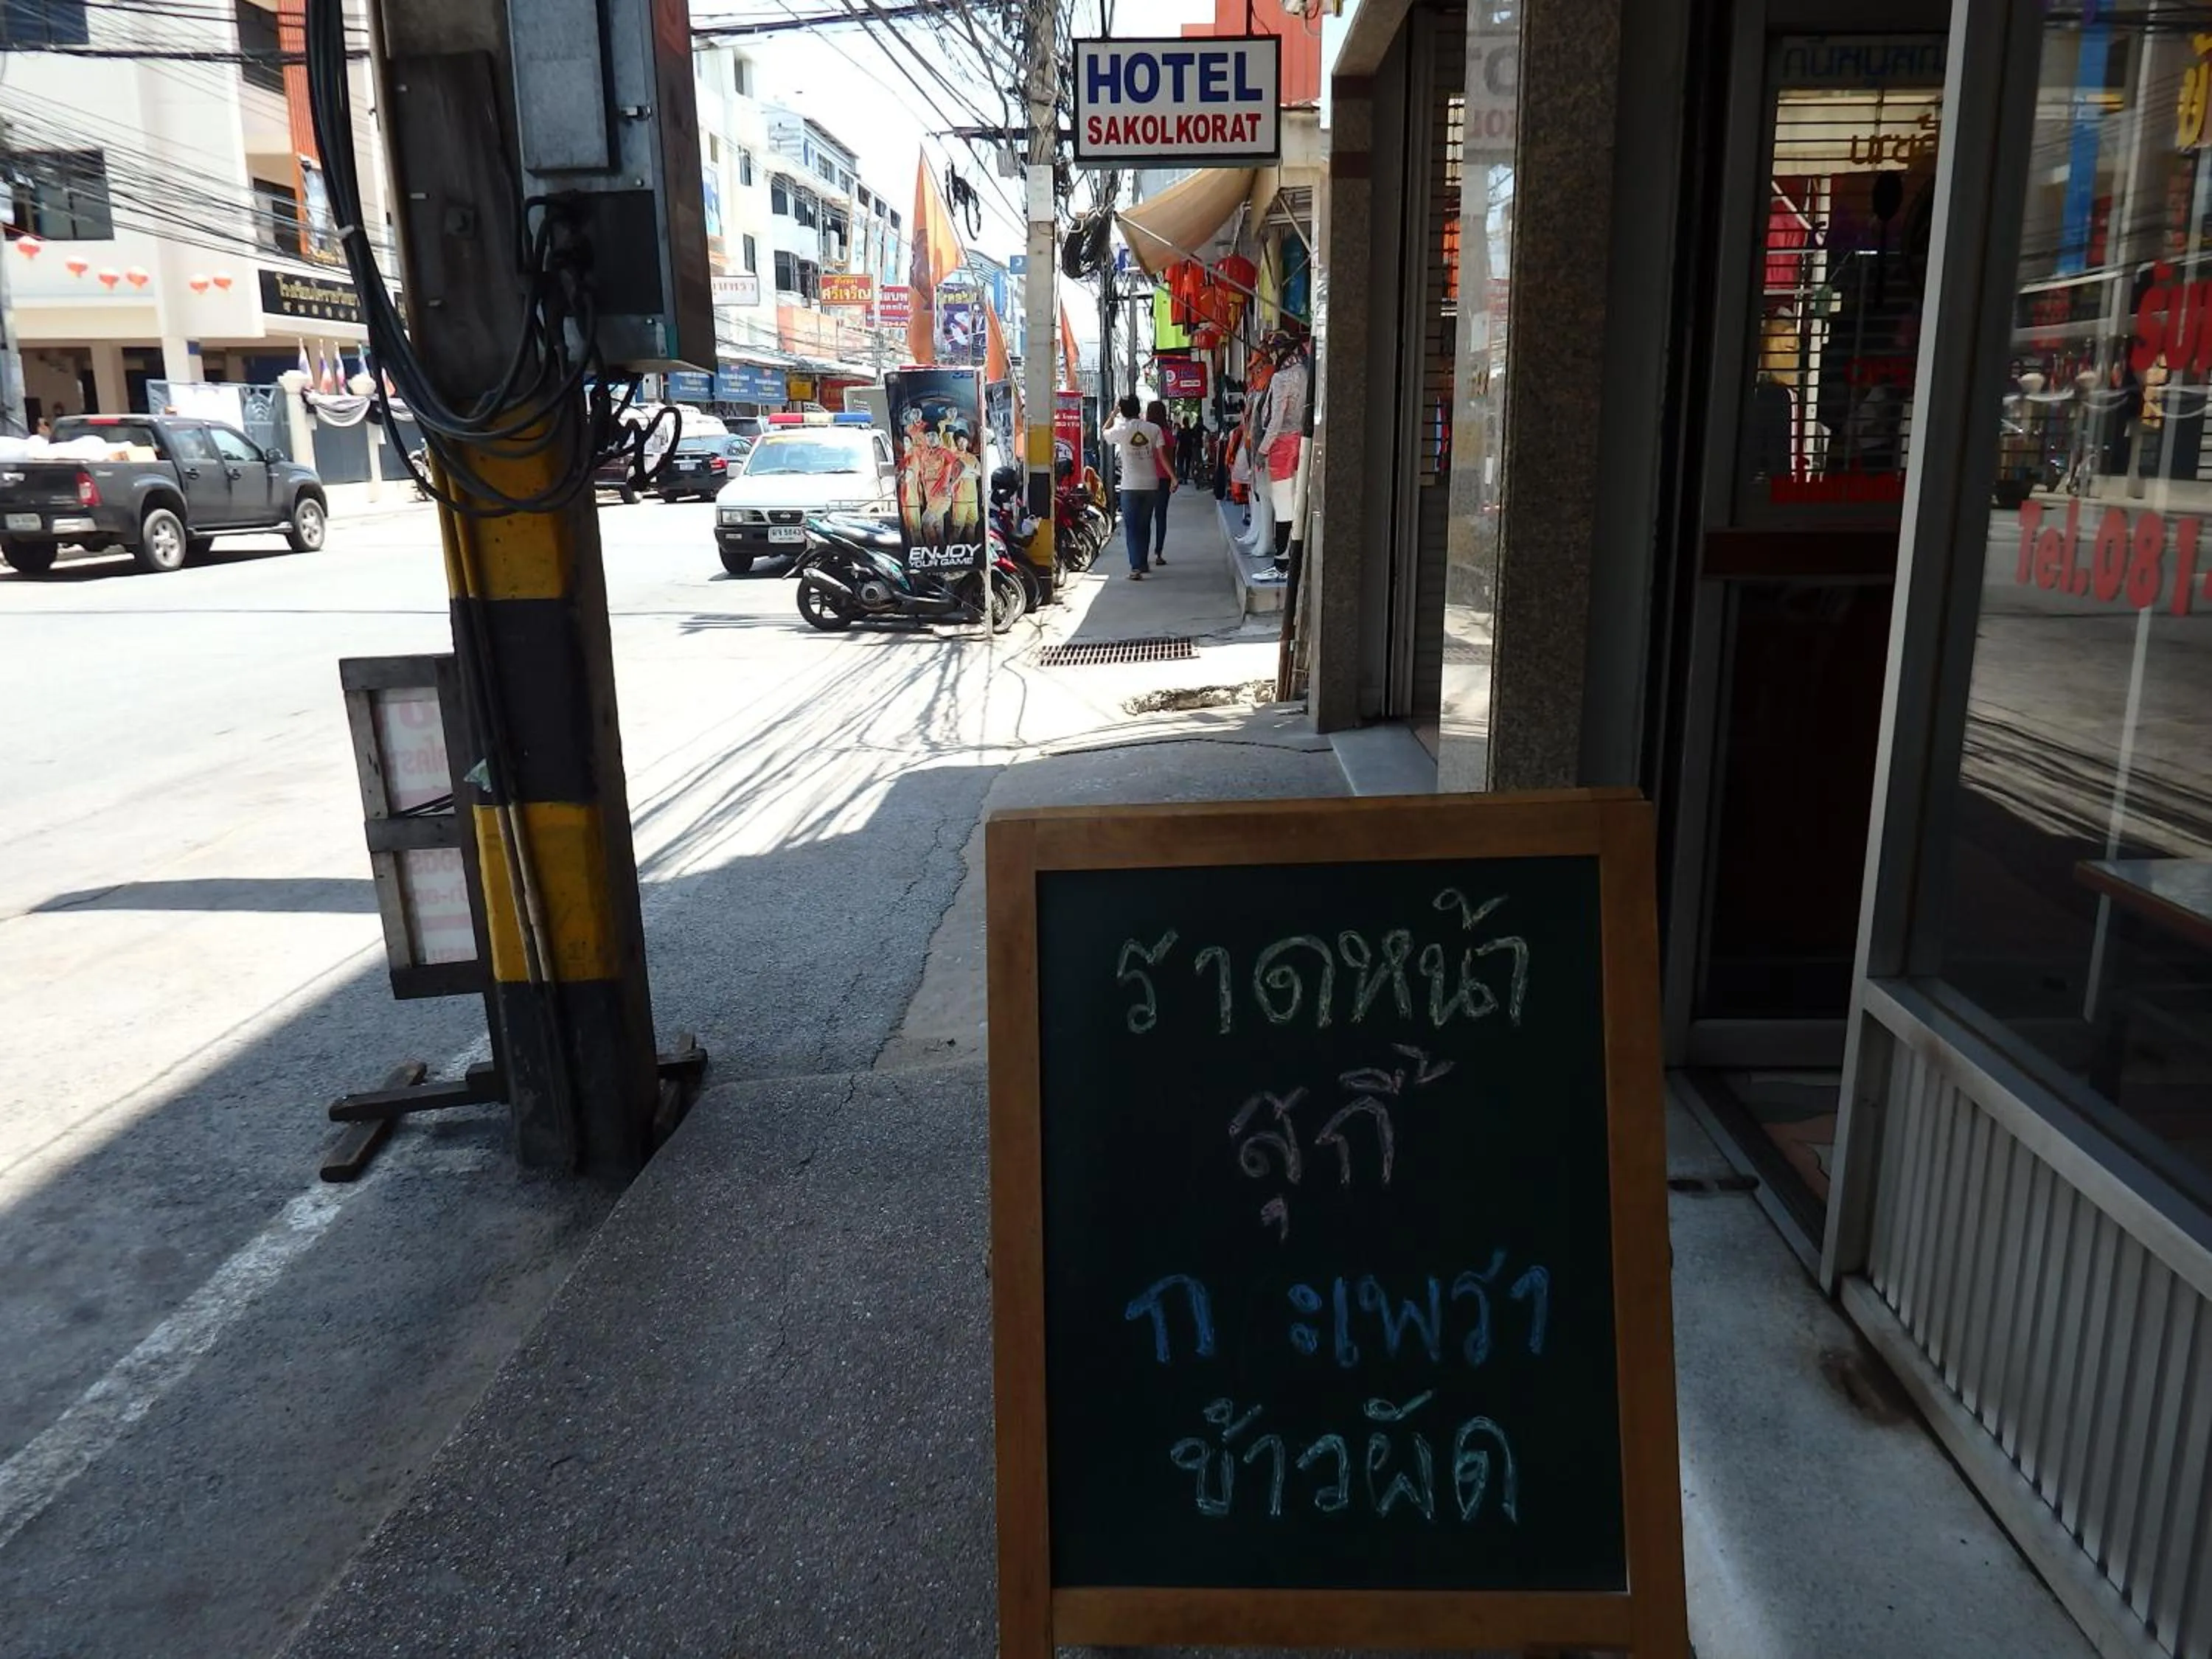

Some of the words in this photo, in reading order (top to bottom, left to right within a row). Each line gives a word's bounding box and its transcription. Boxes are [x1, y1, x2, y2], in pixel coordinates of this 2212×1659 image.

[1087, 52, 1263, 104] HOTEL
[1088, 113, 1262, 145] SAKOLKORAT
[908, 559, 939, 568] YOUR
[940, 557, 974, 566] GAME
[909, 543, 982, 560] ENJOY
[1116, 887, 1529, 1034] ราดหน้า
[1170, 1389, 1517, 1524] ข้าวผัด
